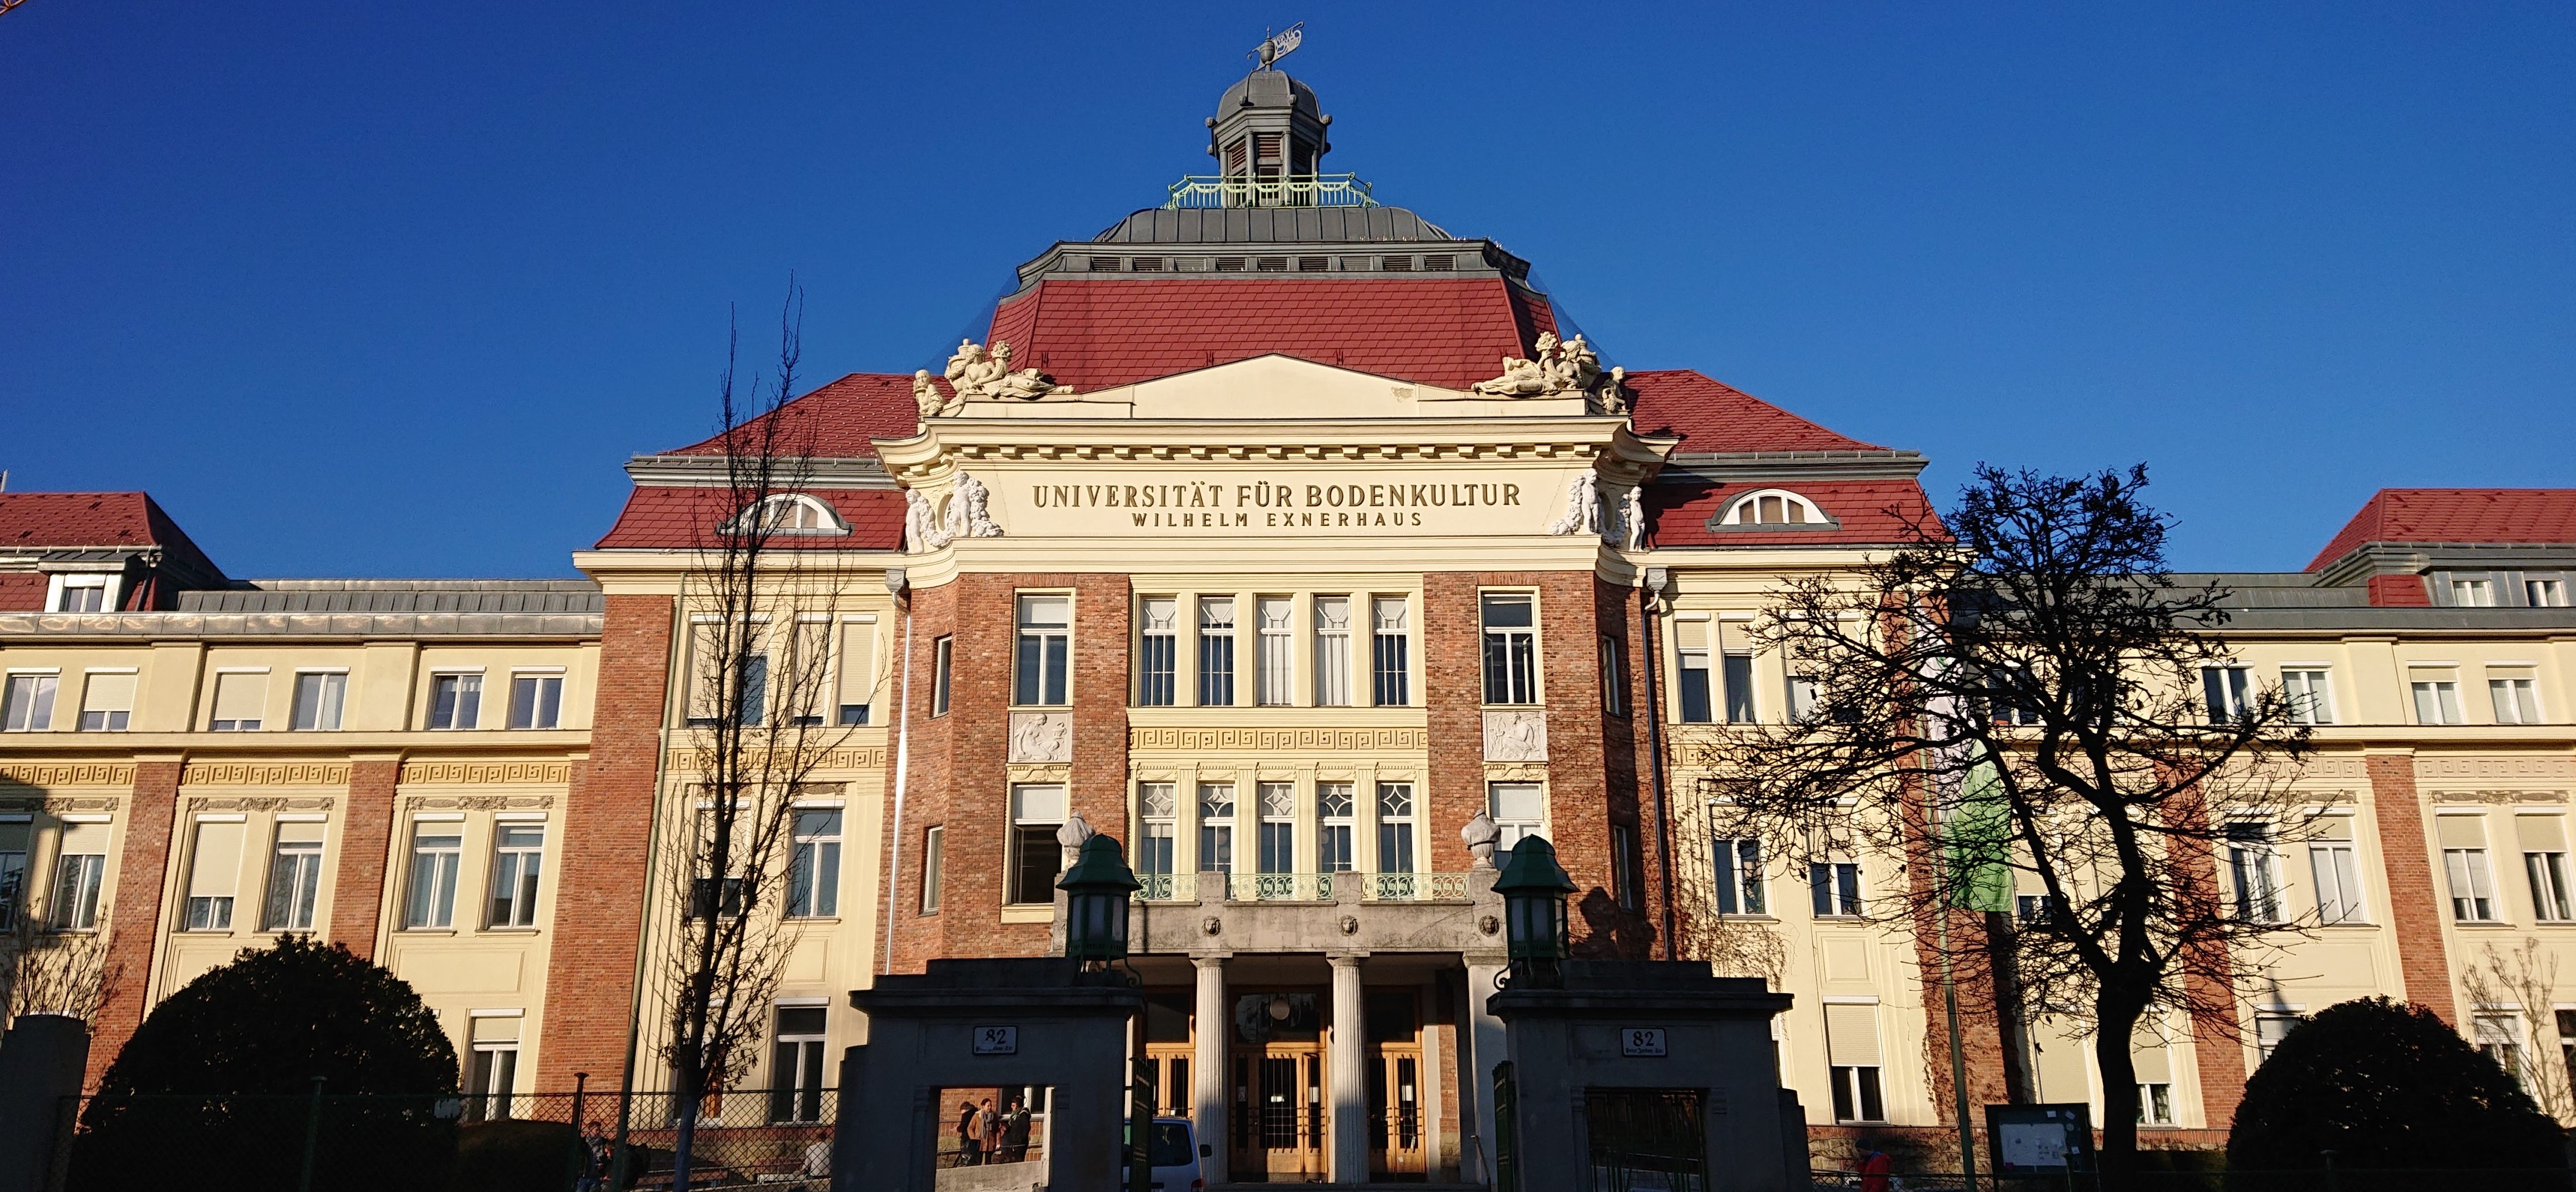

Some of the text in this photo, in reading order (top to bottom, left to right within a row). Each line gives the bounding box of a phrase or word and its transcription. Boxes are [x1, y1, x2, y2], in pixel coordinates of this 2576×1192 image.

[1032, 481, 1521, 508] UNIVERSITÄT FÜR BODENKULTUR
[1131, 512, 1422, 527] WILHELM EXNERHAUS
[985, 1028, 1006, 1044] 82
[1633, 1030, 1655, 1047] 82
